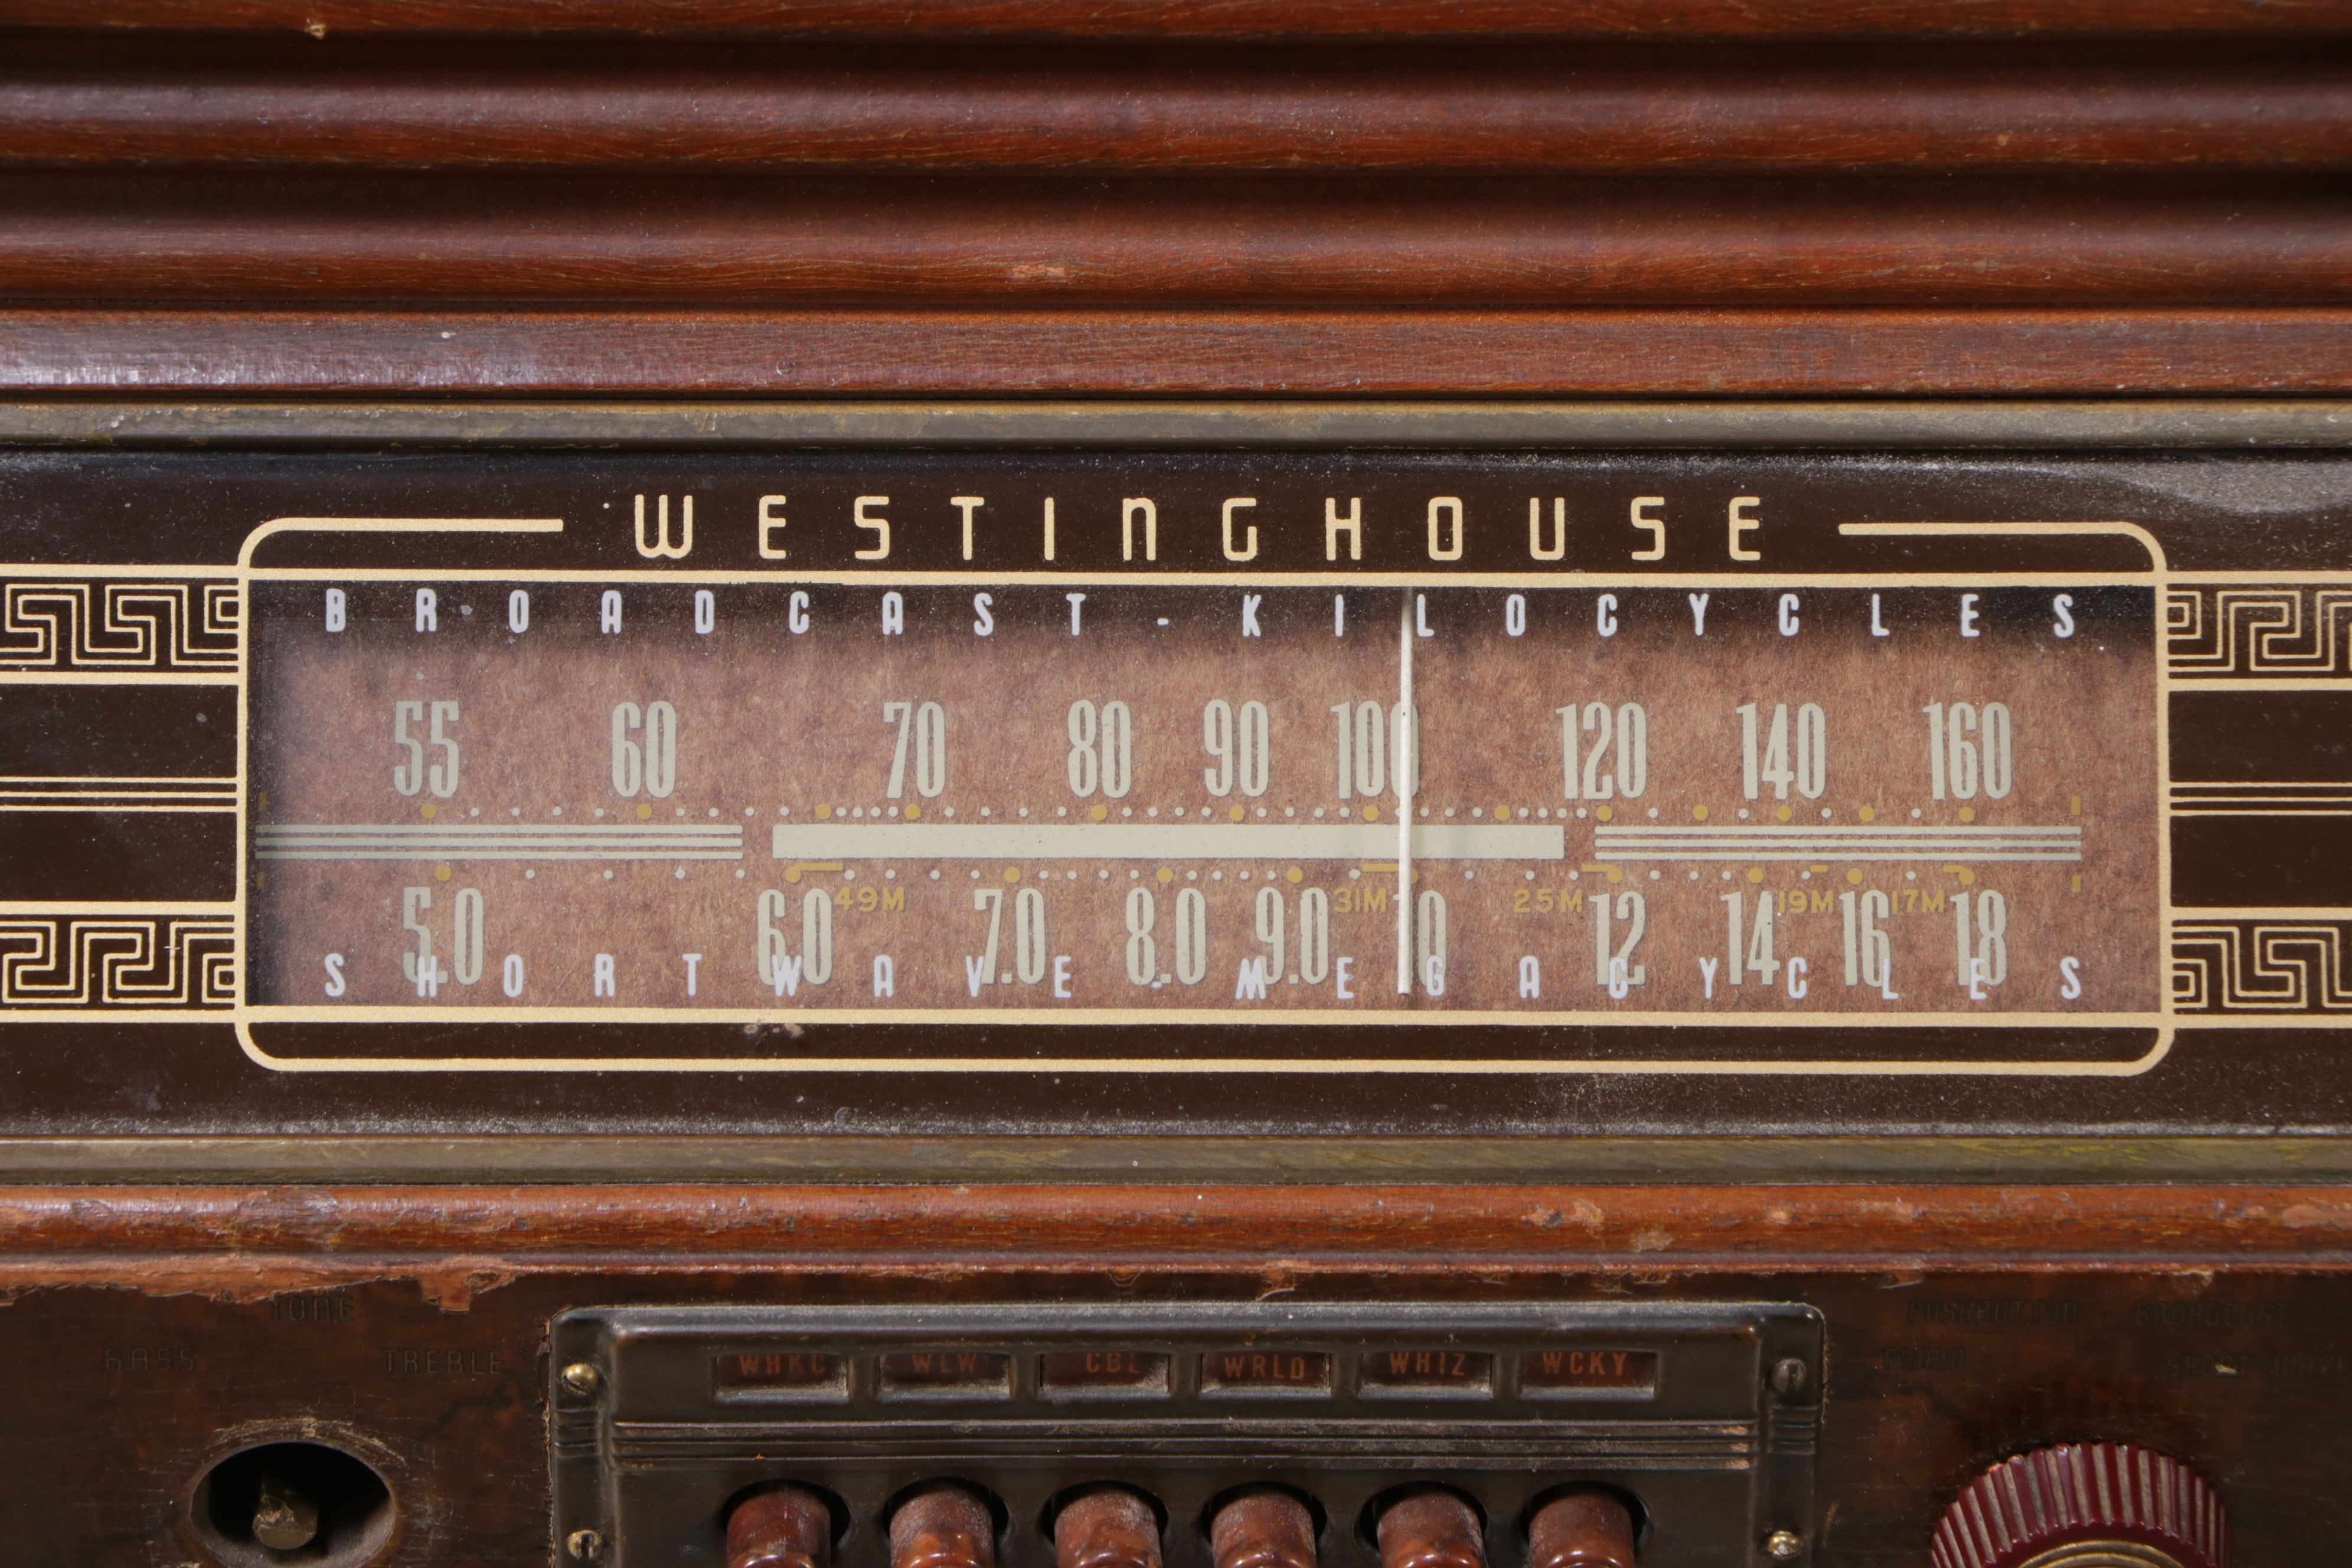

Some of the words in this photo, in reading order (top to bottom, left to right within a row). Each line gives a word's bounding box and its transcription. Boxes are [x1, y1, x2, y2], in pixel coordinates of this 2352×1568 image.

[634, 494, 1760, 561] WESTINGHOUSE
[325, 587, 1086, 636] BROADCAST
[1242, 593, 2075, 638] KILOCYCLES
[394, 700, 460, 798] 55
[612, 700, 677, 798] 60
[883, 701, 945, 799] 70
[1067, 699, 1131, 798] 80
[1204, 699, 1269, 797] 90
[1330, 701, 1417, 799] 100
[1556, 701, 1647, 799] 120
[1735, 702, 1826, 800] 140
[1922, 701, 2011, 800] 160
[834, 887, 905, 912] 49M
[1334, 887, 1387, 913] 31M
[1778, 890, 1834, 913] 19M
[1892, 890, 1945, 913] 17M
[1126, 887, 1206, 985] 8.0
[1255, 887, 1328, 985] 9.0
[1589, 891, 1645, 986] 12
[1720, 890, 1781, 985] 14
[1839, 890, 1890, 986] 16
[1950, 889, 2007, 986] 18
[324, 952, 703, 998] SHORT
[772, 954, 1072, 998] WAVE
[1235, 955, 2082, 1001] MEGACYCLES
[270, 1295, 355, 1322] TONE
[1907, 1299, 2080, 1325] PUSHBUTTON
[104, 1348, 197, 1372] BASS
[382, 1349, 504, 1375] TREBLE
[738, 1354, 827, 1376] WHKC
[1224, 1354, 1306, 1381] WRLD
[1389, 1352, 1467, 1377] WHIZ
[1541, 1352, 1629, 1376] WCKY
